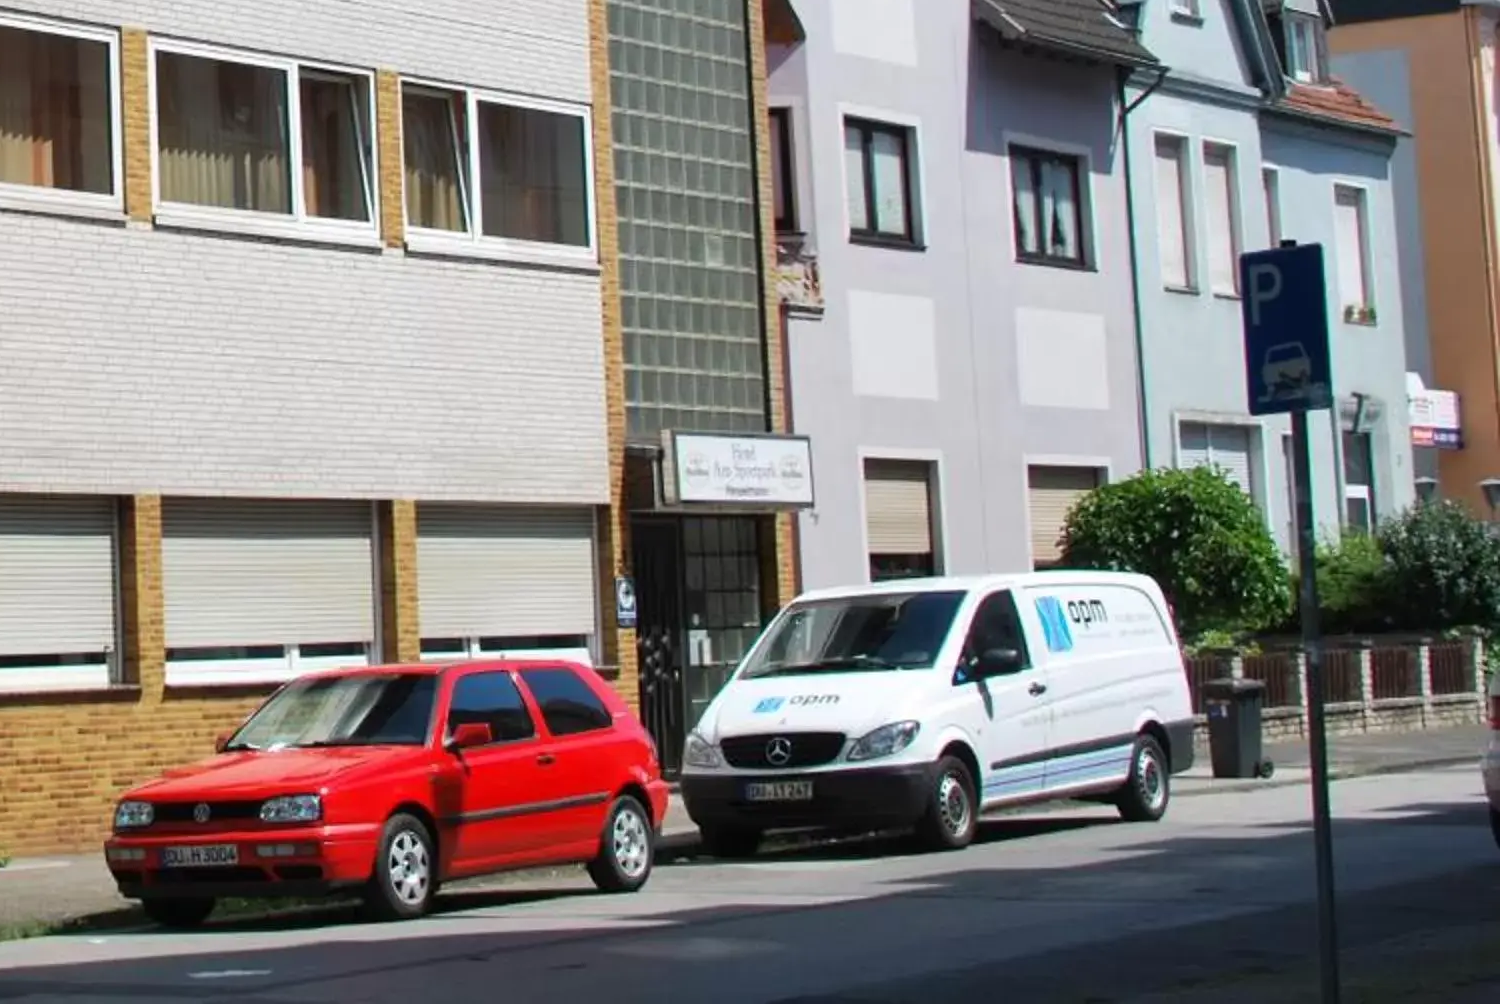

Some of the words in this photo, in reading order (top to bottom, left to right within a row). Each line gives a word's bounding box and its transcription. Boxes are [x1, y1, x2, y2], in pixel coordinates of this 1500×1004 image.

[1250, 263, 1283, 326] P
[1068, 599, 1109, 630] opm
[790, 694, 840, 706] opm
